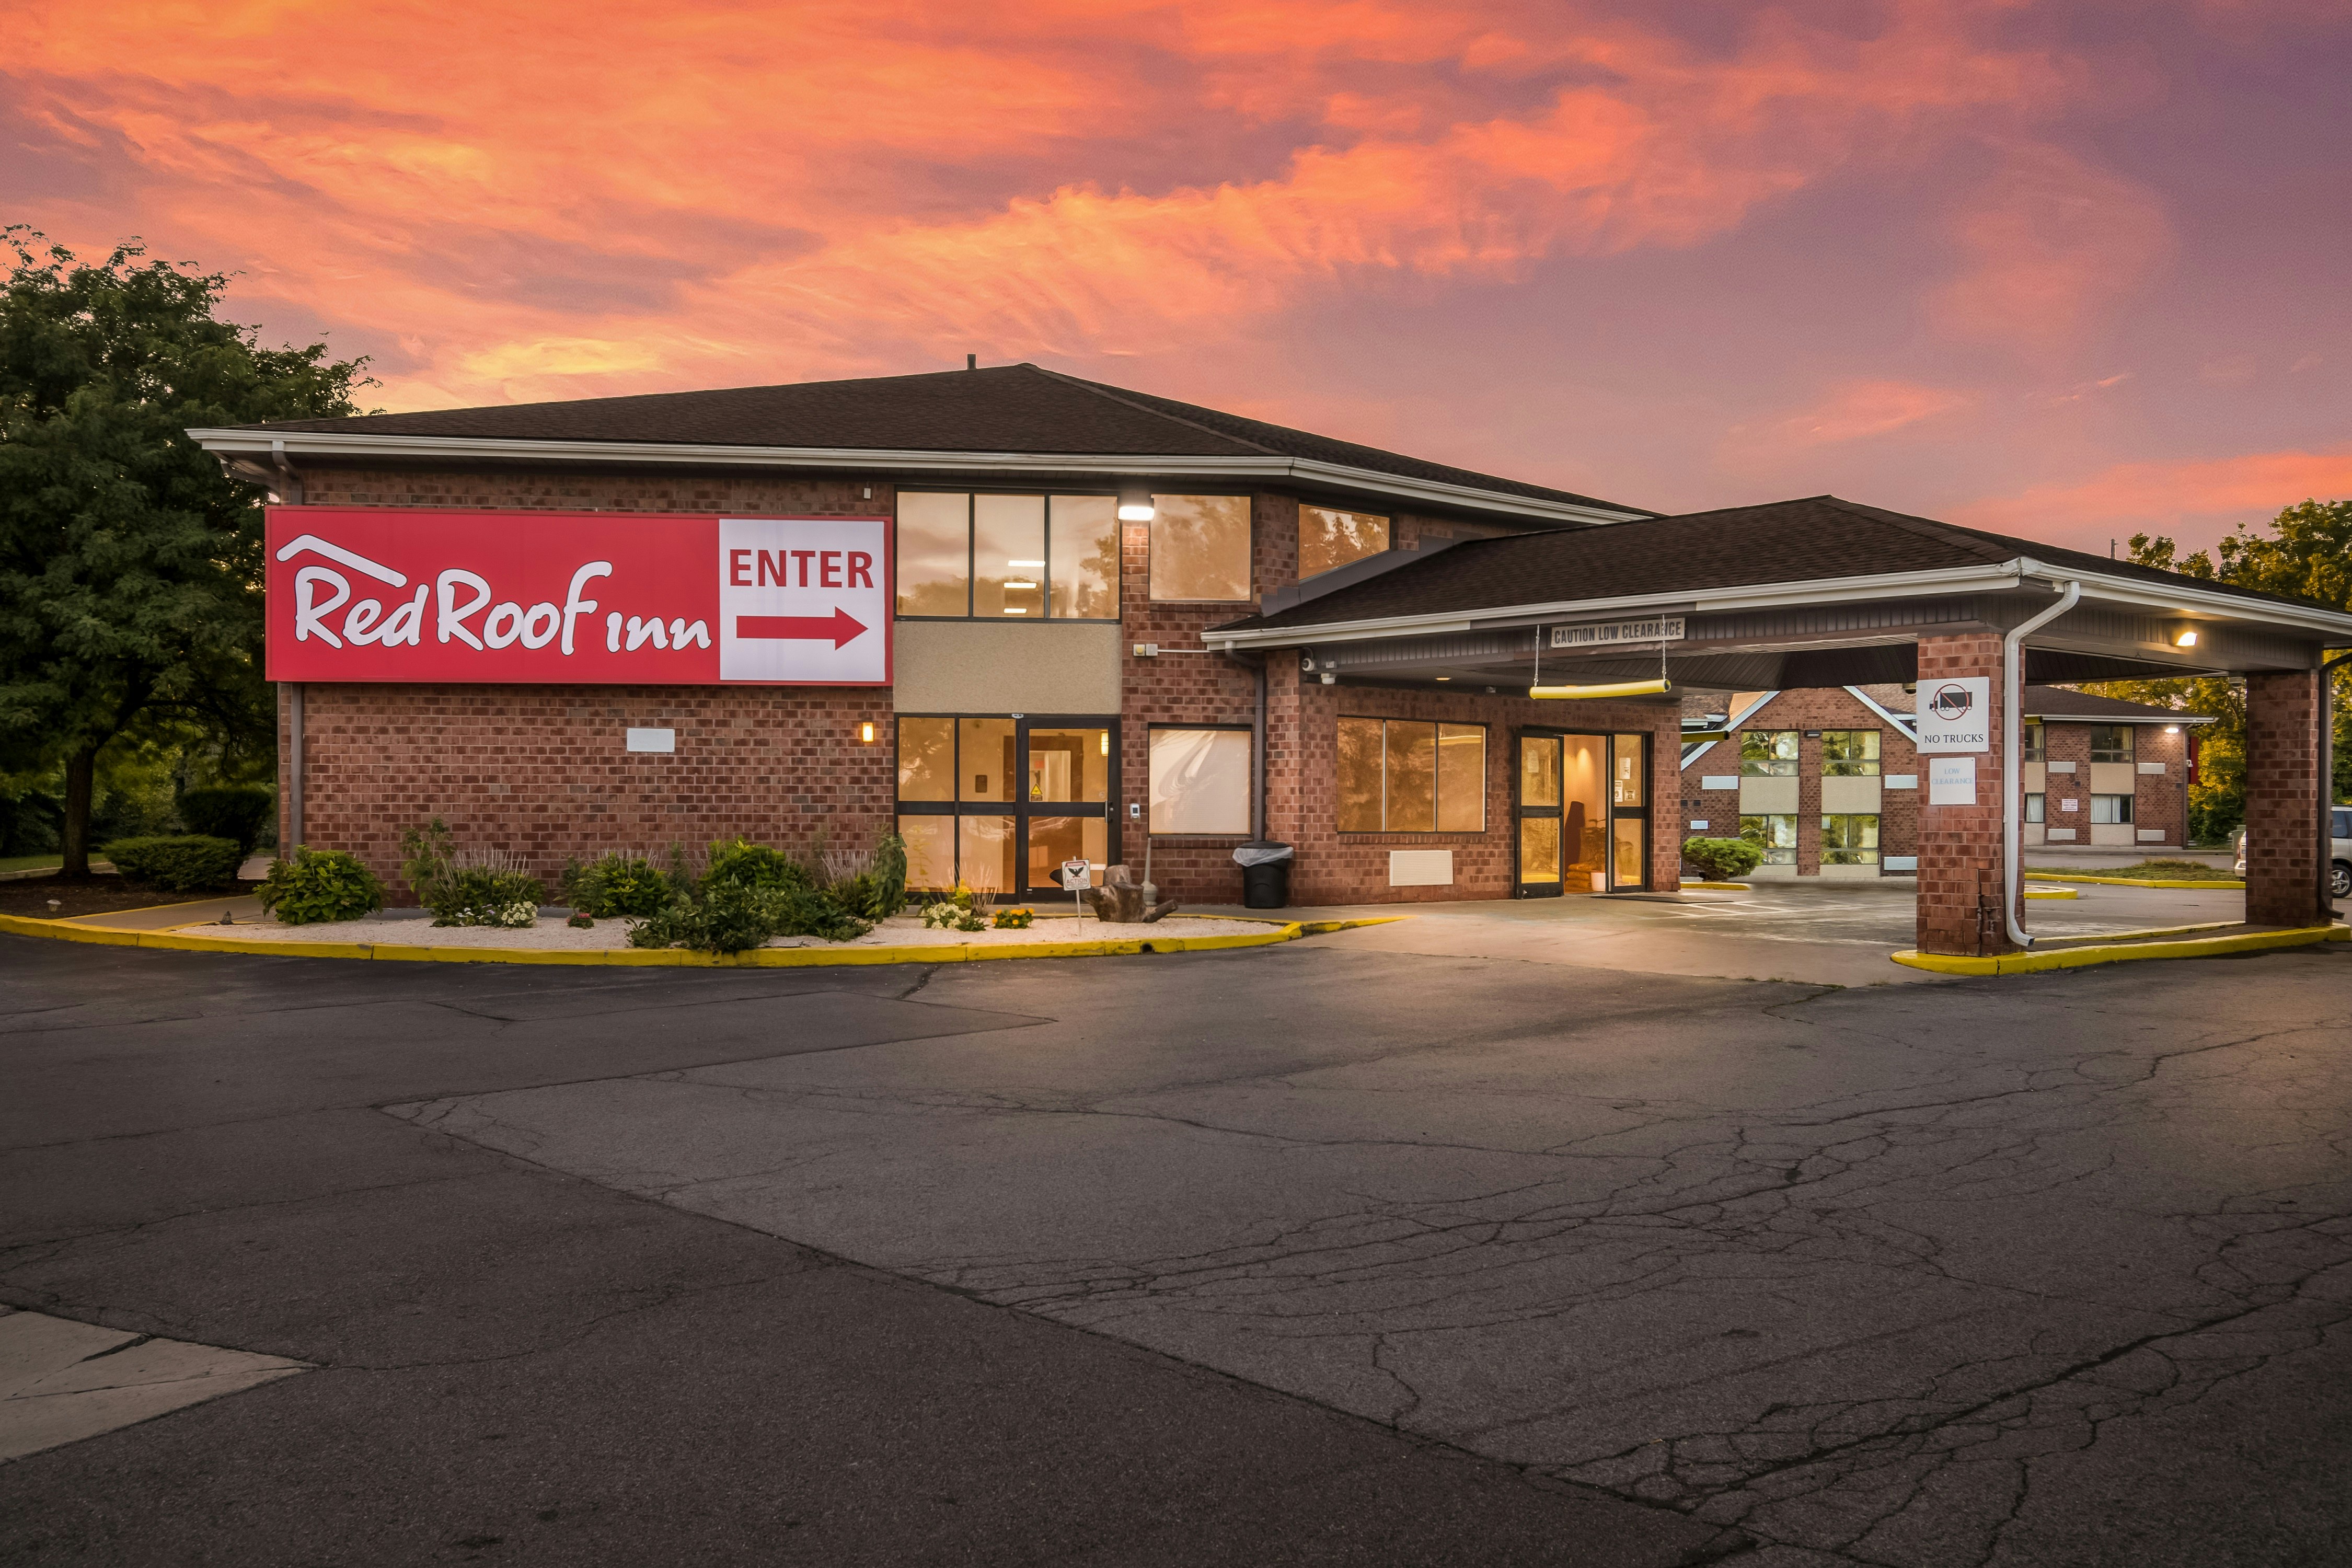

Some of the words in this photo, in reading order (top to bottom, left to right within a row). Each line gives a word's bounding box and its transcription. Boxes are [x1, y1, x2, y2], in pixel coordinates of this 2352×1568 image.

[730, 549, 874, 589] ENTER
[294, 566, 429, 649] Red
[436, 560, 612, 655] Roof
[1554, 627, 1594, 644] CAUTION
[1599, 626, 1619, 640] LOW
[1622, 621, 1681, 639] CLEARANCE
[1924, 735, 1940, 743] NO
[1943, 734, 1984, 743] TRUCKS
